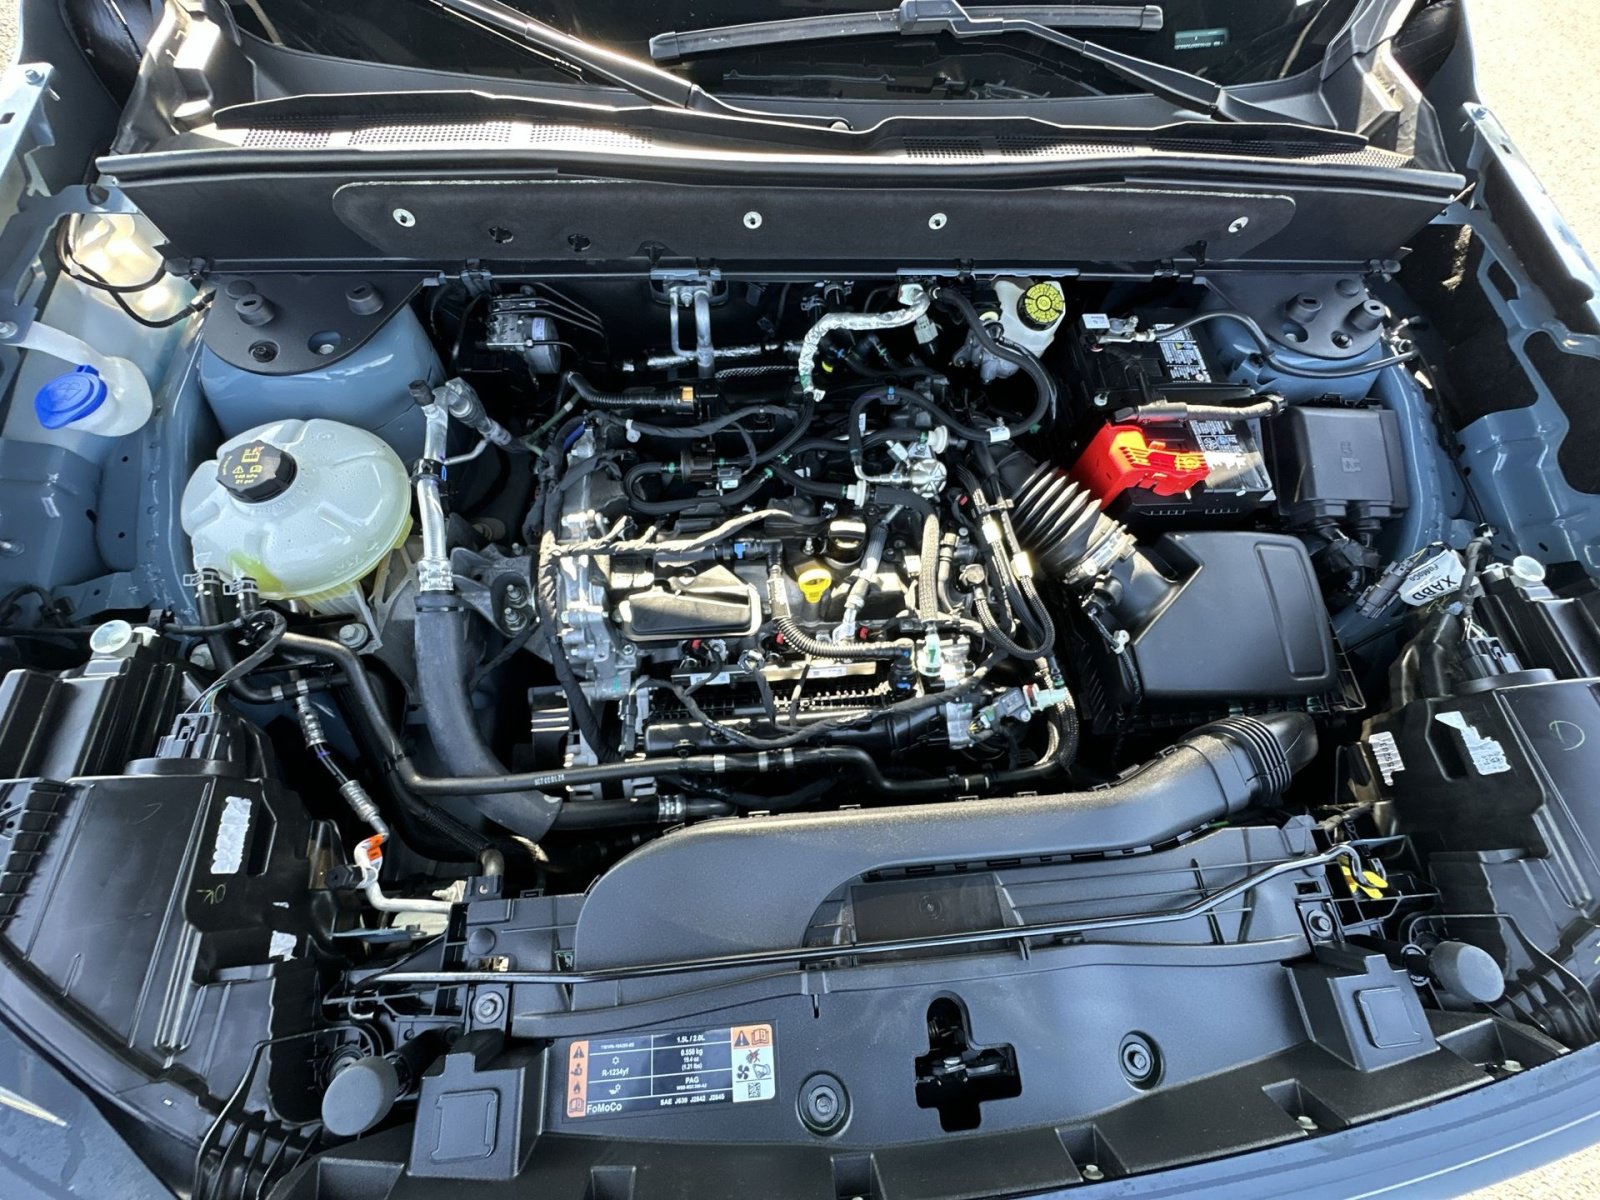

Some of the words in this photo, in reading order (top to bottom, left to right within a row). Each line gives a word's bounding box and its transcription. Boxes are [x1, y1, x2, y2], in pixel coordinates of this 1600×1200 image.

[1409, 564, 1438, 582] FoMoCo
[1412, 575, 1458, 601] XABD
[696, 1048, 704, 1056] kg
[602, 1067, 629, 1077] R-1234yf
[685, 1076, 699, 1084] PAG
[586, 1102, 622, 1114] FoMoCo
